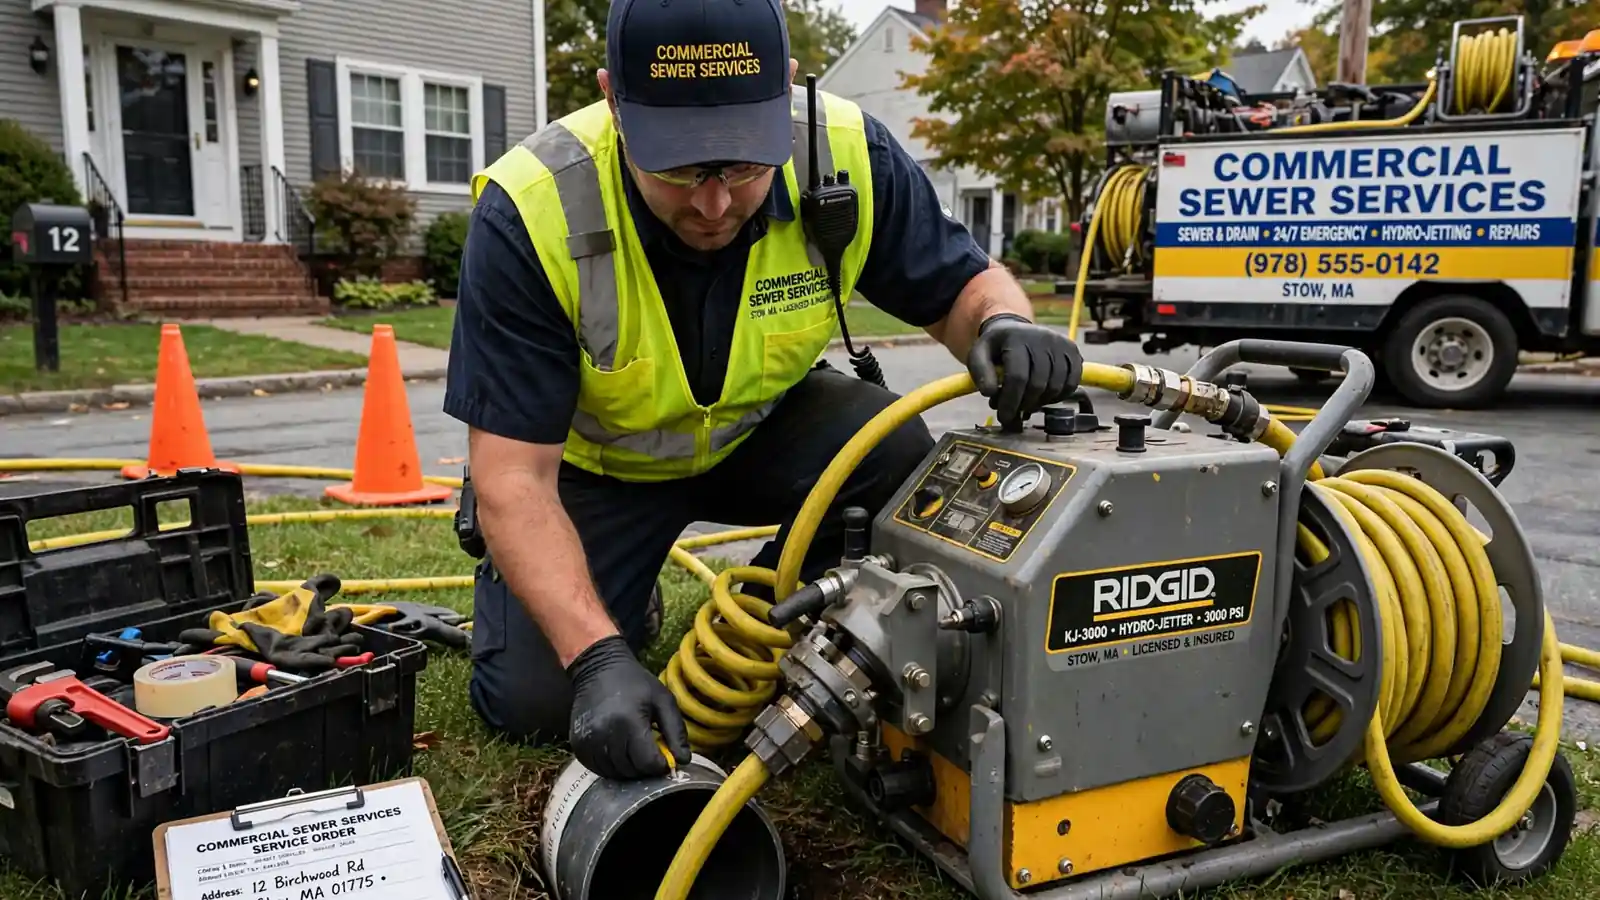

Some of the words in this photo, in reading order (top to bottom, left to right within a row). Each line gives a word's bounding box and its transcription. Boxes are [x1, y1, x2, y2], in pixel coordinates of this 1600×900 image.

[657, 42, 753, 60] COMMERCIAL
[650, 63, 696, 78] SEWER
[700, 58, 760, 77] SERVICES
[1214, 144, 1511, 182] COMMERCIAL
[1178, 187, 1315, 217] SEWER
[1329, 180, 1546, 214] SERVICES
[48, 226, 80, 252] 12
[1178, 226, 1214, 242] SEWER
[1216, 226, 1224, 241] &
[1226, 226, 1259, 241] DRAIN
[1273, 226, 1298, 242] 24/7
[1301, 225, 1368, 241] EMERGENCY
[1382, 224, 1472, 241] HYDRO-JETTING
[1489, 224, 1540, 240] REPAIRS
[1245, 252, 1307, 277] (978)
[1317, 252, 1440, 274] 555-0142
[756, 267, 826, 292] COMMERCIAL
[1282, 283, 1327, 299] STOW,
[1332, 284, 1354, 298] MA
[749, 291, 785, 307] SEWER
[1065, 626, 1107, 643] KJ-3000
[1119, 613, 1193, 636] HYDRO-JETTER
[1204, 609, 1227, 623] 3000
[1229, 606, 1244, 620] PSI
[1067, 651, 1101, 666] STOW,
[1103, 648, 1119, 660] MA
[1132, 638, 1181, 656] LICENSED
[1184, 637, 1191, 648] &
[1193, 630, 1235, 647] INSURED
[196, 829, 289, 853] COMMERCIAL
[292, 820, 338, 836] SEWER
[341, 807, 402, 826] SERVICES
[252, 836, 309, 855] SERVICE
[311, 826, 357, 843] ORDER
[201, 888, 243, 900] Address:
[252, 880, 267, 894] 12
[274, 864, 340, 889] Birchwood
[347, 858, 365, 874] Rd
[300, 886, 324, 900] MA
[331, 874, 374, 895] 01775
